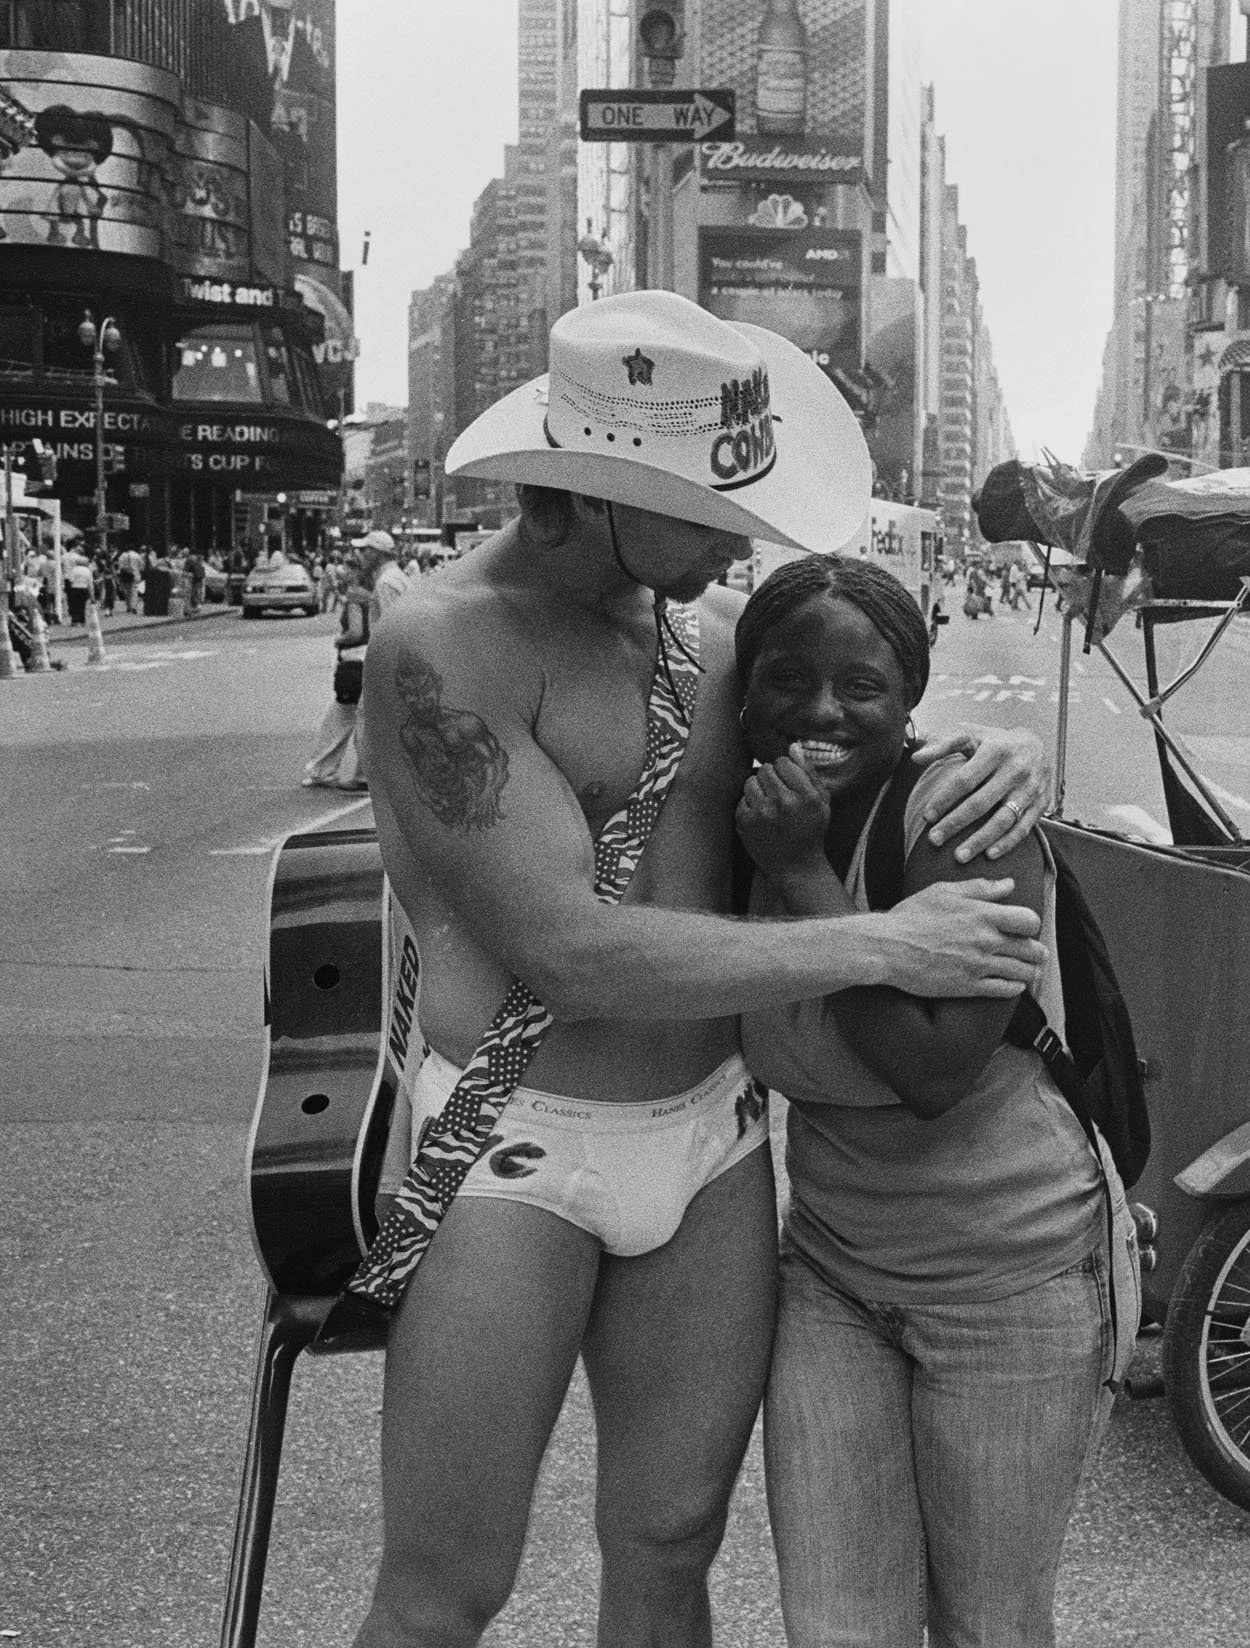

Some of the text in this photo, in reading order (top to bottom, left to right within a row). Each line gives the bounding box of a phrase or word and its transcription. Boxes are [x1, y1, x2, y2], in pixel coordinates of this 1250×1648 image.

[602, 106, 716, 127] ONE WAY
[702, 142, 861, 170] Budweiser
[183, 278, 232, 303] Twist
[235, 286, 273, 306] and
[1, 409, 53, 427] HIGH
[208, 455, 251, 471] CUP
[388, 935, 420, 1064] NAKED
